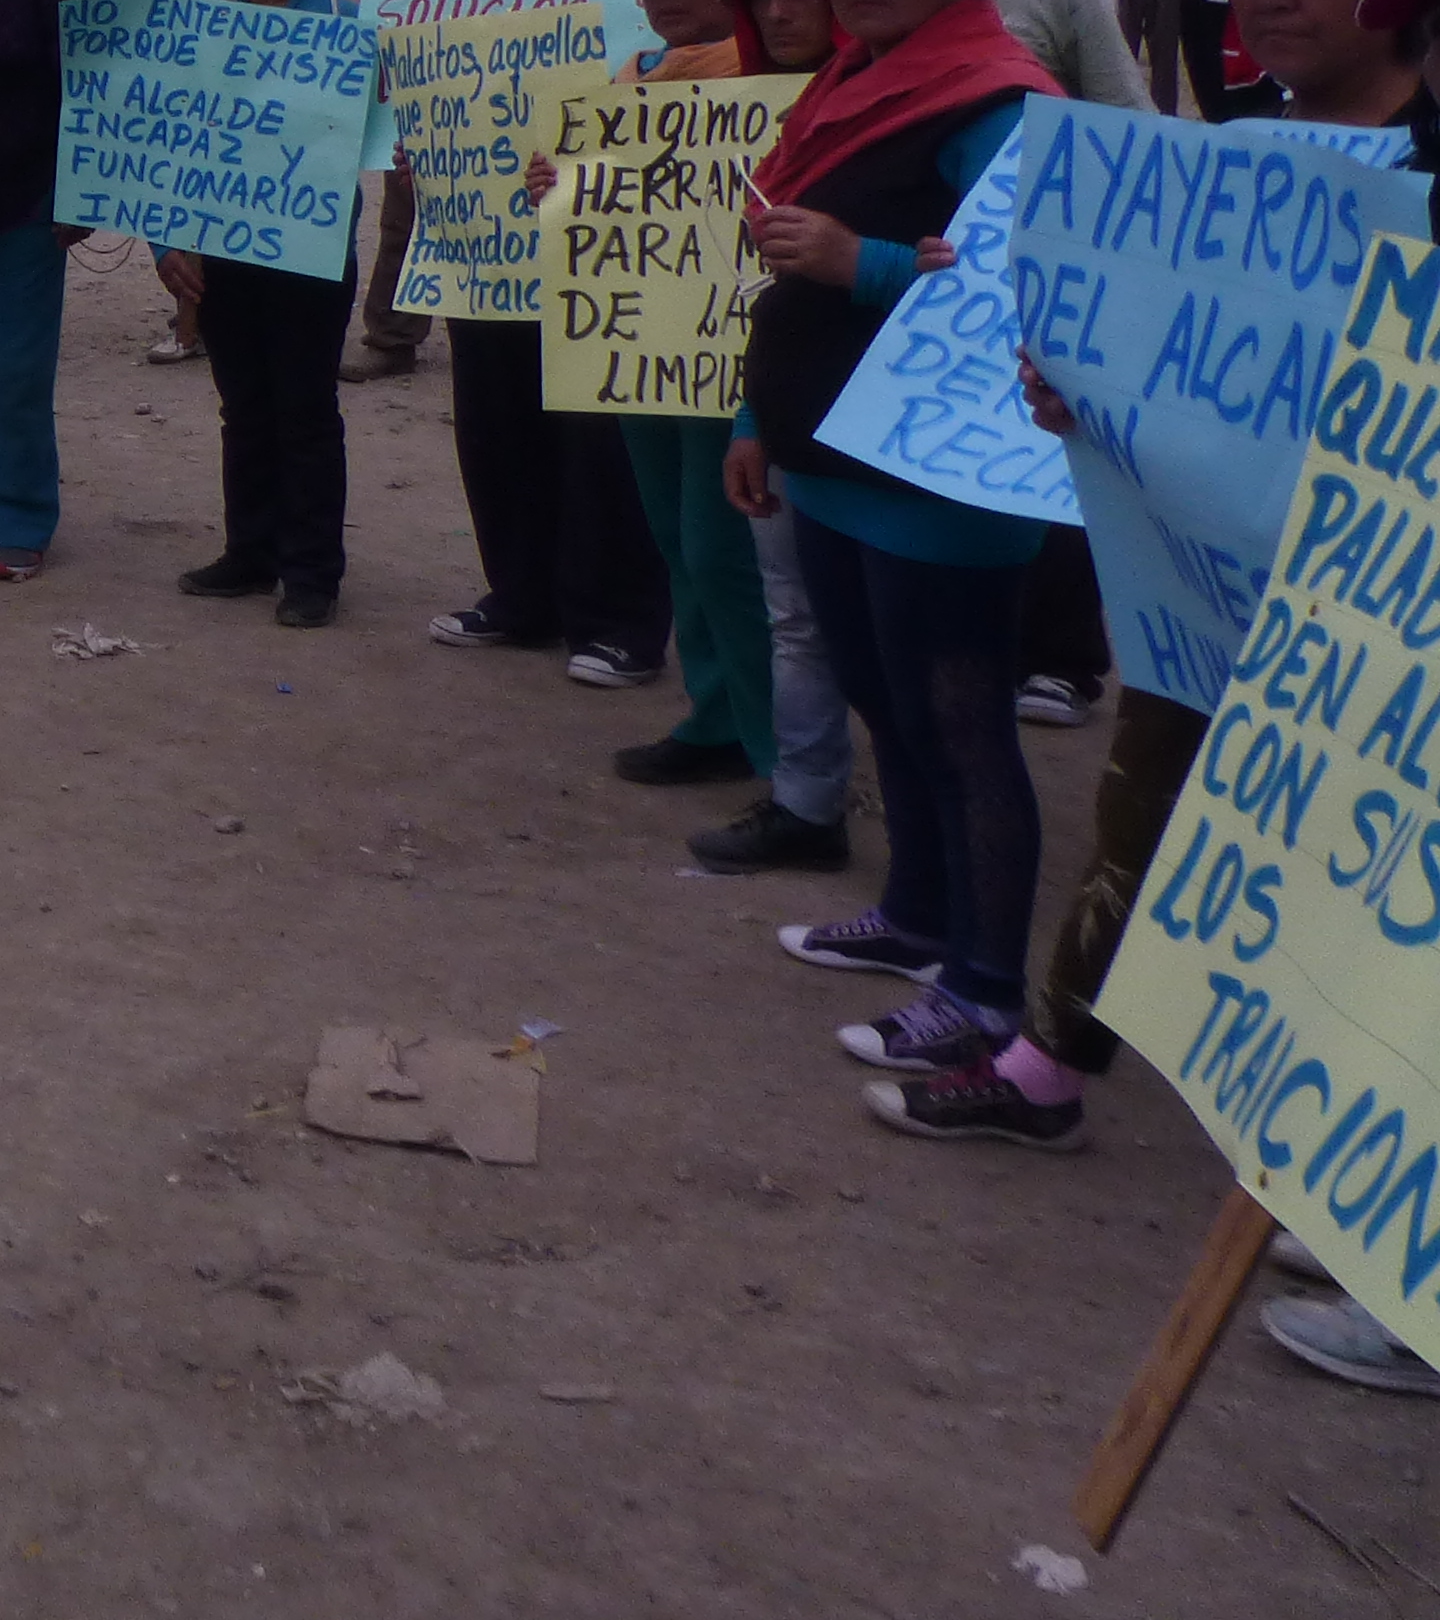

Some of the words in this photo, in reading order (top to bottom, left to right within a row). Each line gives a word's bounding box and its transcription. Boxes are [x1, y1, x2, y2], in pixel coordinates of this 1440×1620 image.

[65, 28, 199, 66] PORQUE
[222, 44, 372, 97] EXISTE
[489, 14, 606, 93] aquellos
[67, 69, 109, 102] UN
[123, 74, 286, 136] ALCALDE
[431, 94, 469, 128] con
[64, 108, 243, 165] INCAPAZ
[280, 143, 305, 185] Y
[71, 145, 340, 228] FUNCIONARIOS
[509, 188, 533, 220] a
[1022, 114, 1363, 290] AYAYEROS
[75, 192, 282, 261] INEPTOS
[564, 223, 701, 277] PARA
[396, 268, 442, 308] los
[557, 290, 643, 340] DE
[696, 283, 752, 337] LA
[1015, 256, 1106, 366] DEL
[1233, 598, 1366, 730] DEN
[1203, 704, 1329, 850] CON
[1150, 817, 1283, 962] LOS
